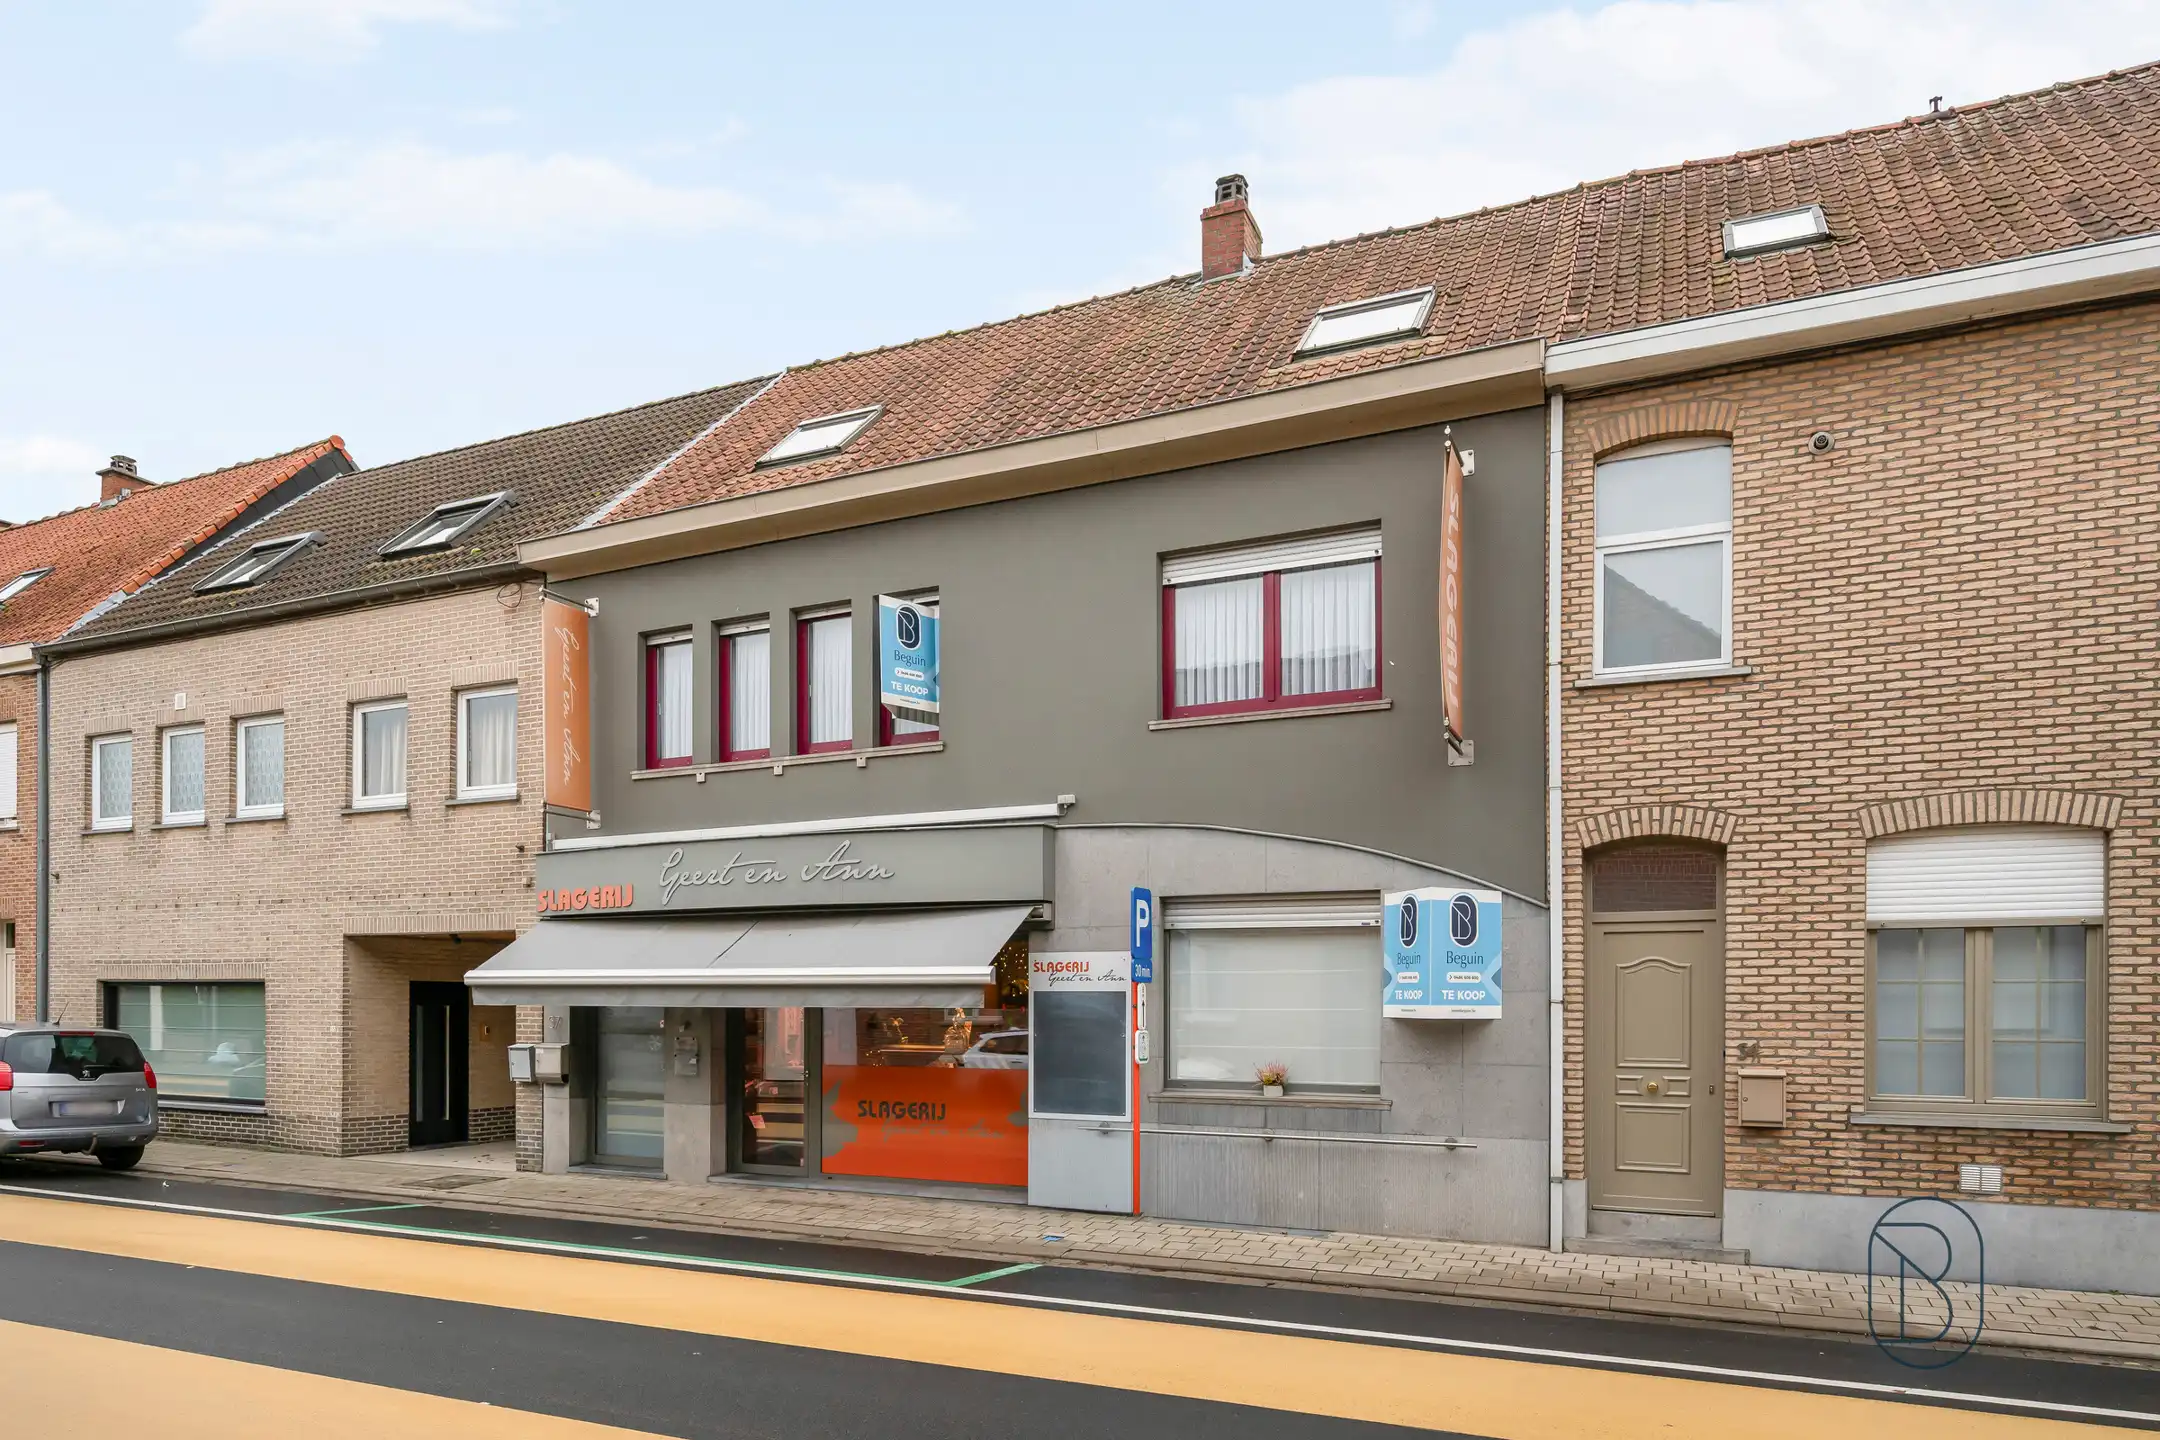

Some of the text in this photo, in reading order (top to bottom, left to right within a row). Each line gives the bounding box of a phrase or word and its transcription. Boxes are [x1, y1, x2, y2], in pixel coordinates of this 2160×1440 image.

[1446, 485, 1460, 709] SLAGERIJ
[893, 649, 926, 667] Beguin
[890, 681, 929, 696] TE KOOP
[659, 839, 895, 906] Geert en Ann
[537, 883, 635, 913] SLAGERIJ
[1136, 899, 1150, 948] P
[1033, 961, 1090, 973] SLAGERIJ
[1396, 952, 1421, 969] Beguin
[1446, 950, 1484, 969] Beguin
[1048, 969, 1127, 987] Geert en Ann
[1135, 964, 1142, 978] 30
[1394, 990, 1423, 1000] TE KOOP
[1441, 990, 1486, 1001] TE KOOP
[858, 1100, 947, 1121] SLAGERIJ
